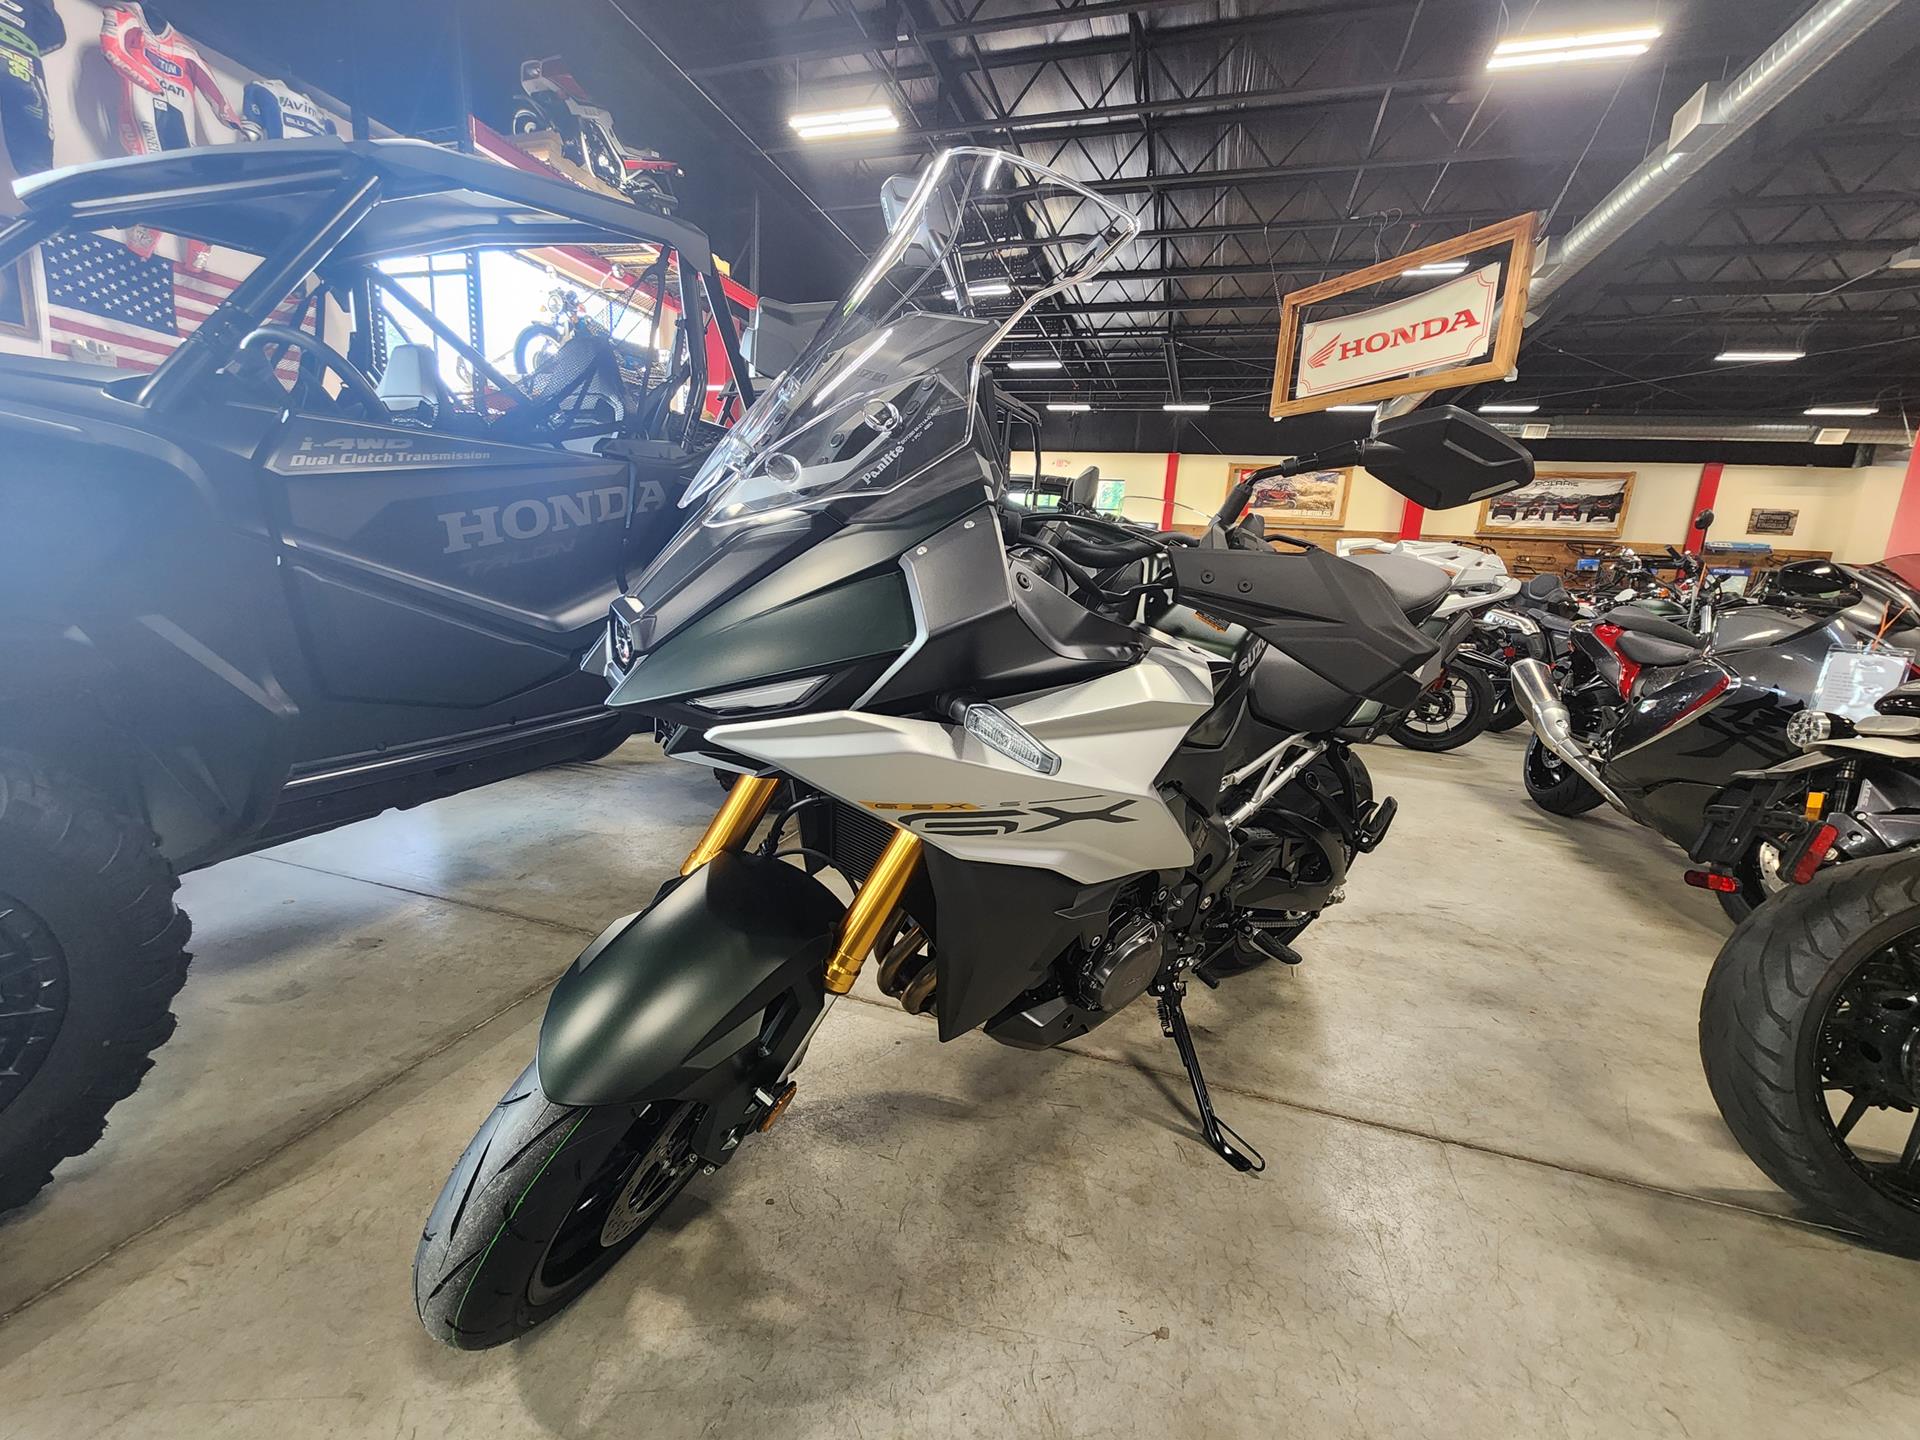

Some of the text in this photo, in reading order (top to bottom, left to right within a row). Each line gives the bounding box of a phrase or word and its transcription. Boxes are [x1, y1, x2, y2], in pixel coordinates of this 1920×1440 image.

[156, 78, 186, 98] CATI
[1338, 308, 1480, 361] HONDA
[290, 450, 491, 467] Dual Clutch Transmission
[300, 437, 414, 450] i-4WD
[862, 445, 905, 485] Panlite
[437, 480, 667, 554] HONDA
